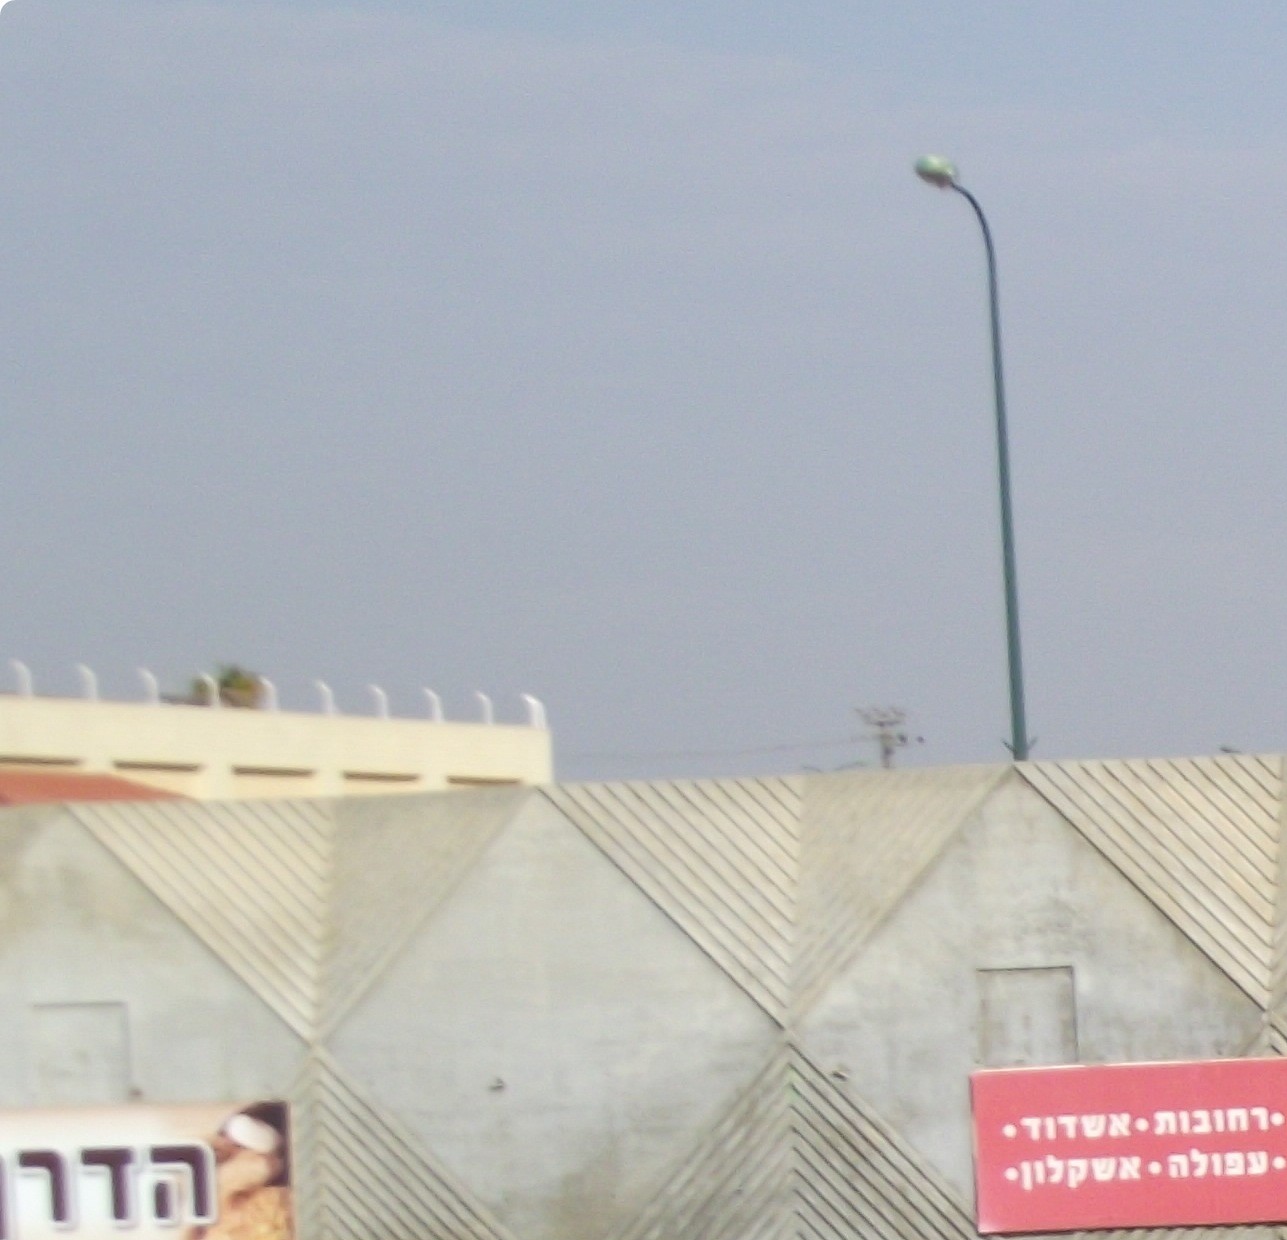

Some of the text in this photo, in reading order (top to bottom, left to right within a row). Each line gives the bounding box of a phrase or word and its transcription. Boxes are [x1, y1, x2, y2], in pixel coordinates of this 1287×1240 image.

[1019, 1107, 1269, 1141] רחובות אשדוד
[1020, 1148, 1269, 1191] עפולה אשקלון
